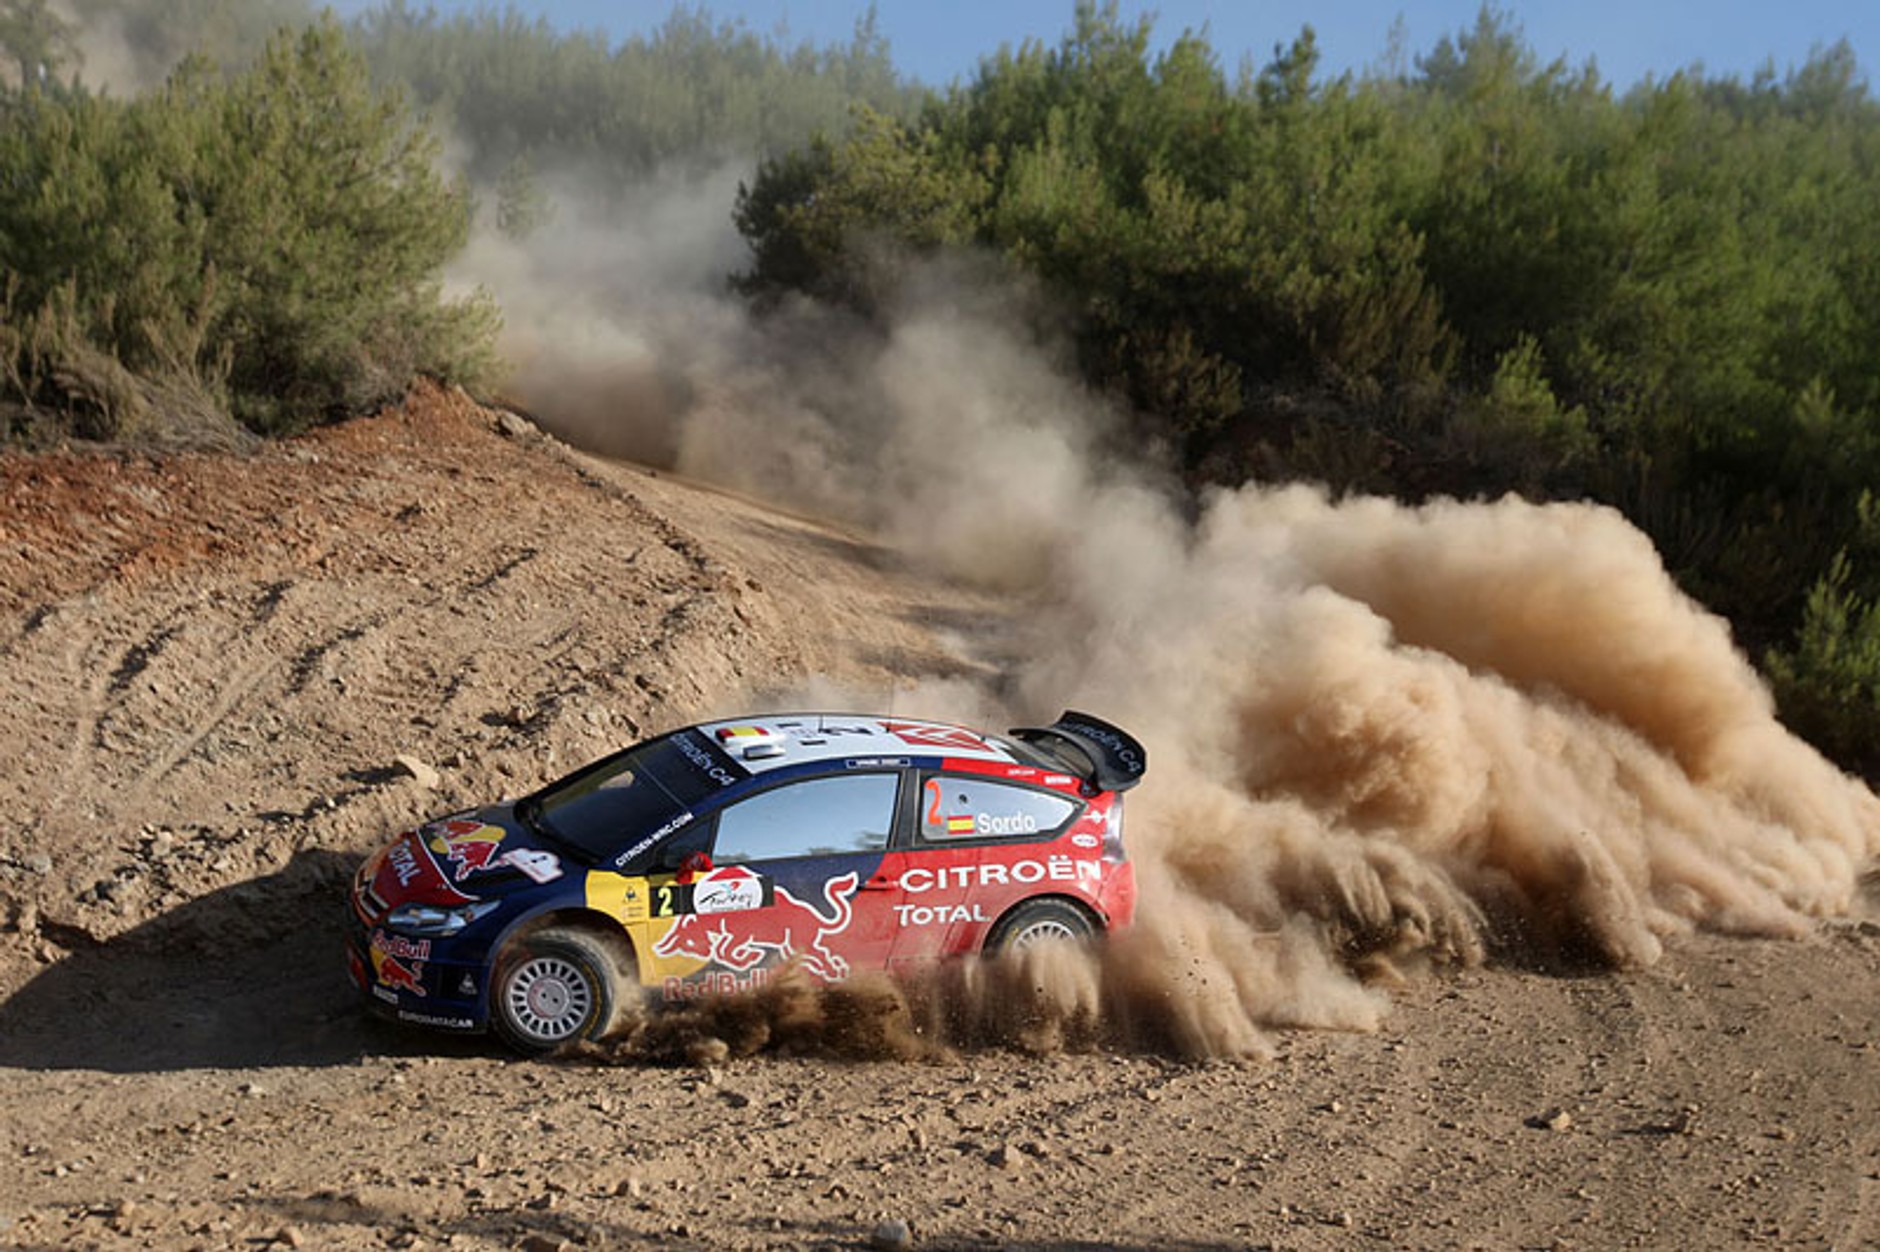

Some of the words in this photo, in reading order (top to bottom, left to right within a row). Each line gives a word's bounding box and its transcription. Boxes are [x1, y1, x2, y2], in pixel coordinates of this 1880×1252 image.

[925, 779, 943, 826] 2
[977, 811, 1036, 834] Sordo
[900, 855, 1101, 892] CITROËN
[658, 887, 673, 916] 2
[893, 904, 988, 927] TOTAL
[663, 971, 715, 1000] Red
